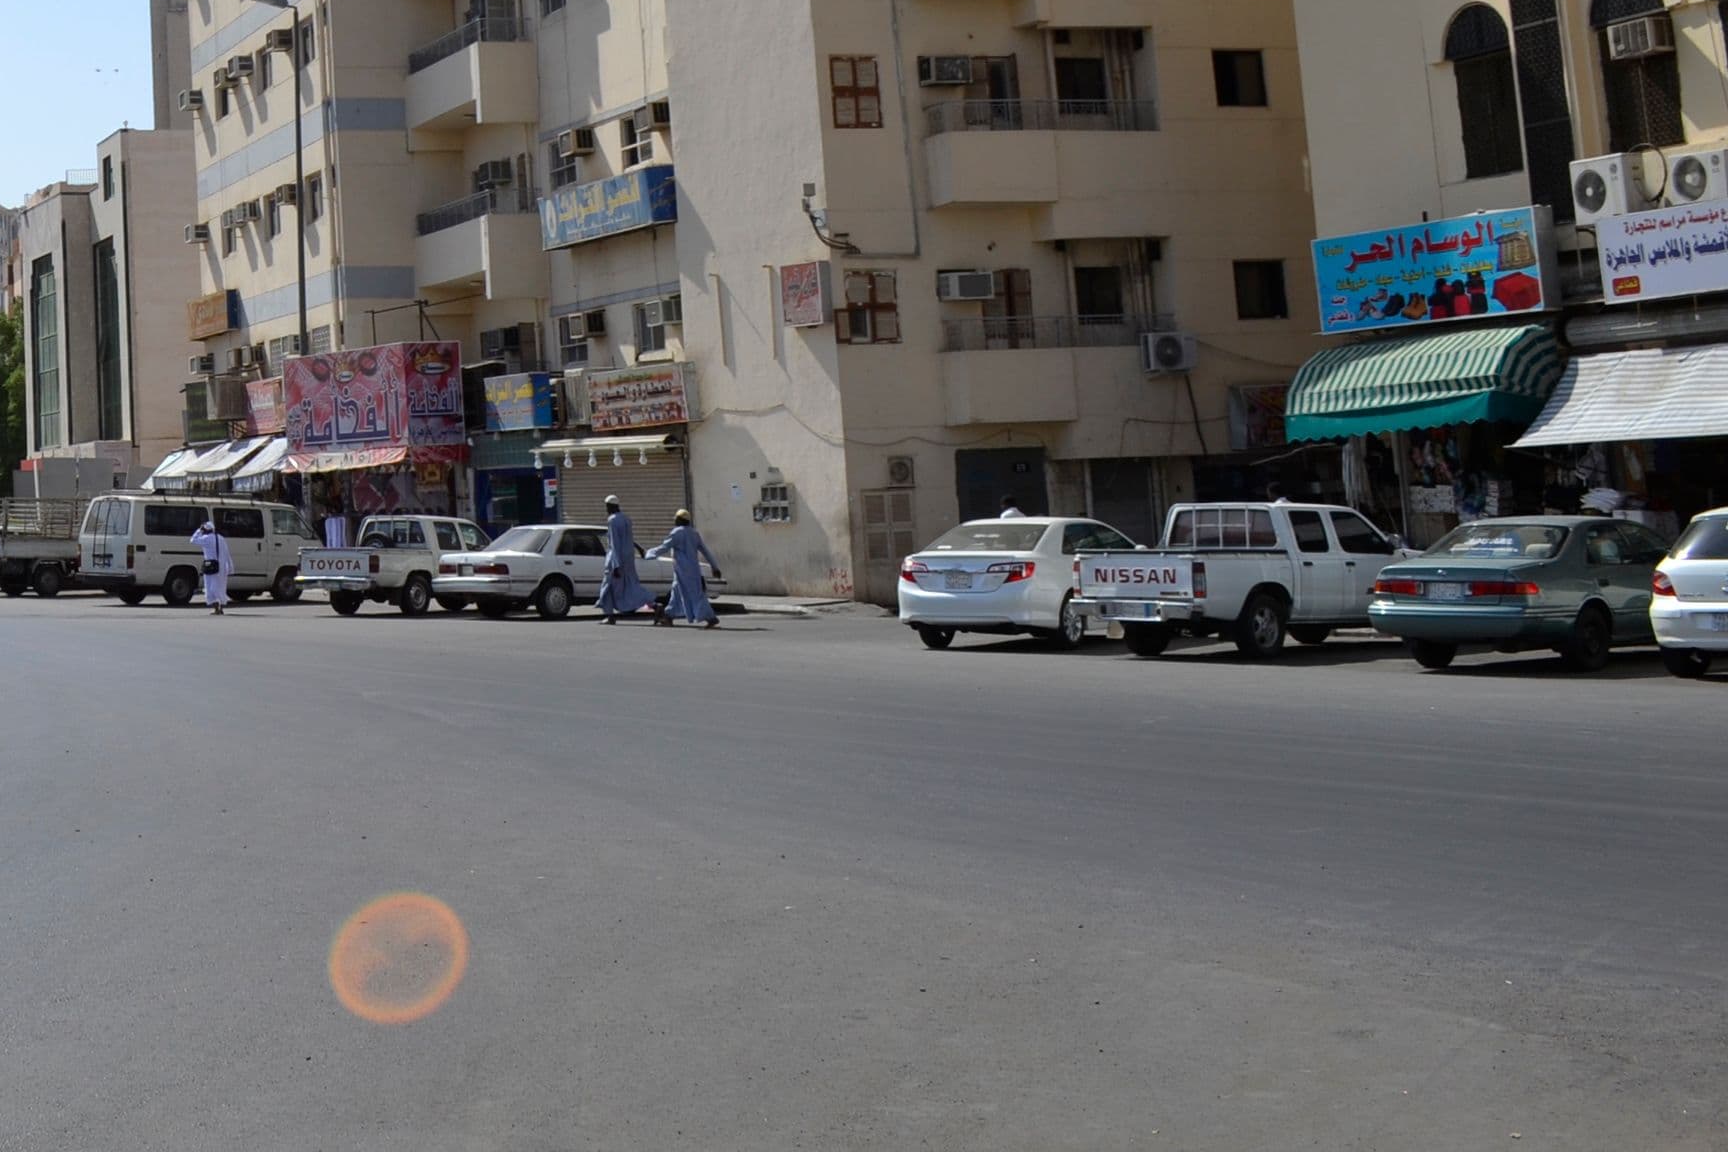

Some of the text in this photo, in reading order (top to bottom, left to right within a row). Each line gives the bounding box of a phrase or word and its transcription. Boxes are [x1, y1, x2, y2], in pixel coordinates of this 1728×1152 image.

[1344, 220, 1495, 273] الوسام الحر
[1605, 242, 1645, 272] الجاهزة
[309, 559, 361, 571] TOYOTA
[1094, 567, 1177, 585] NISSAN
